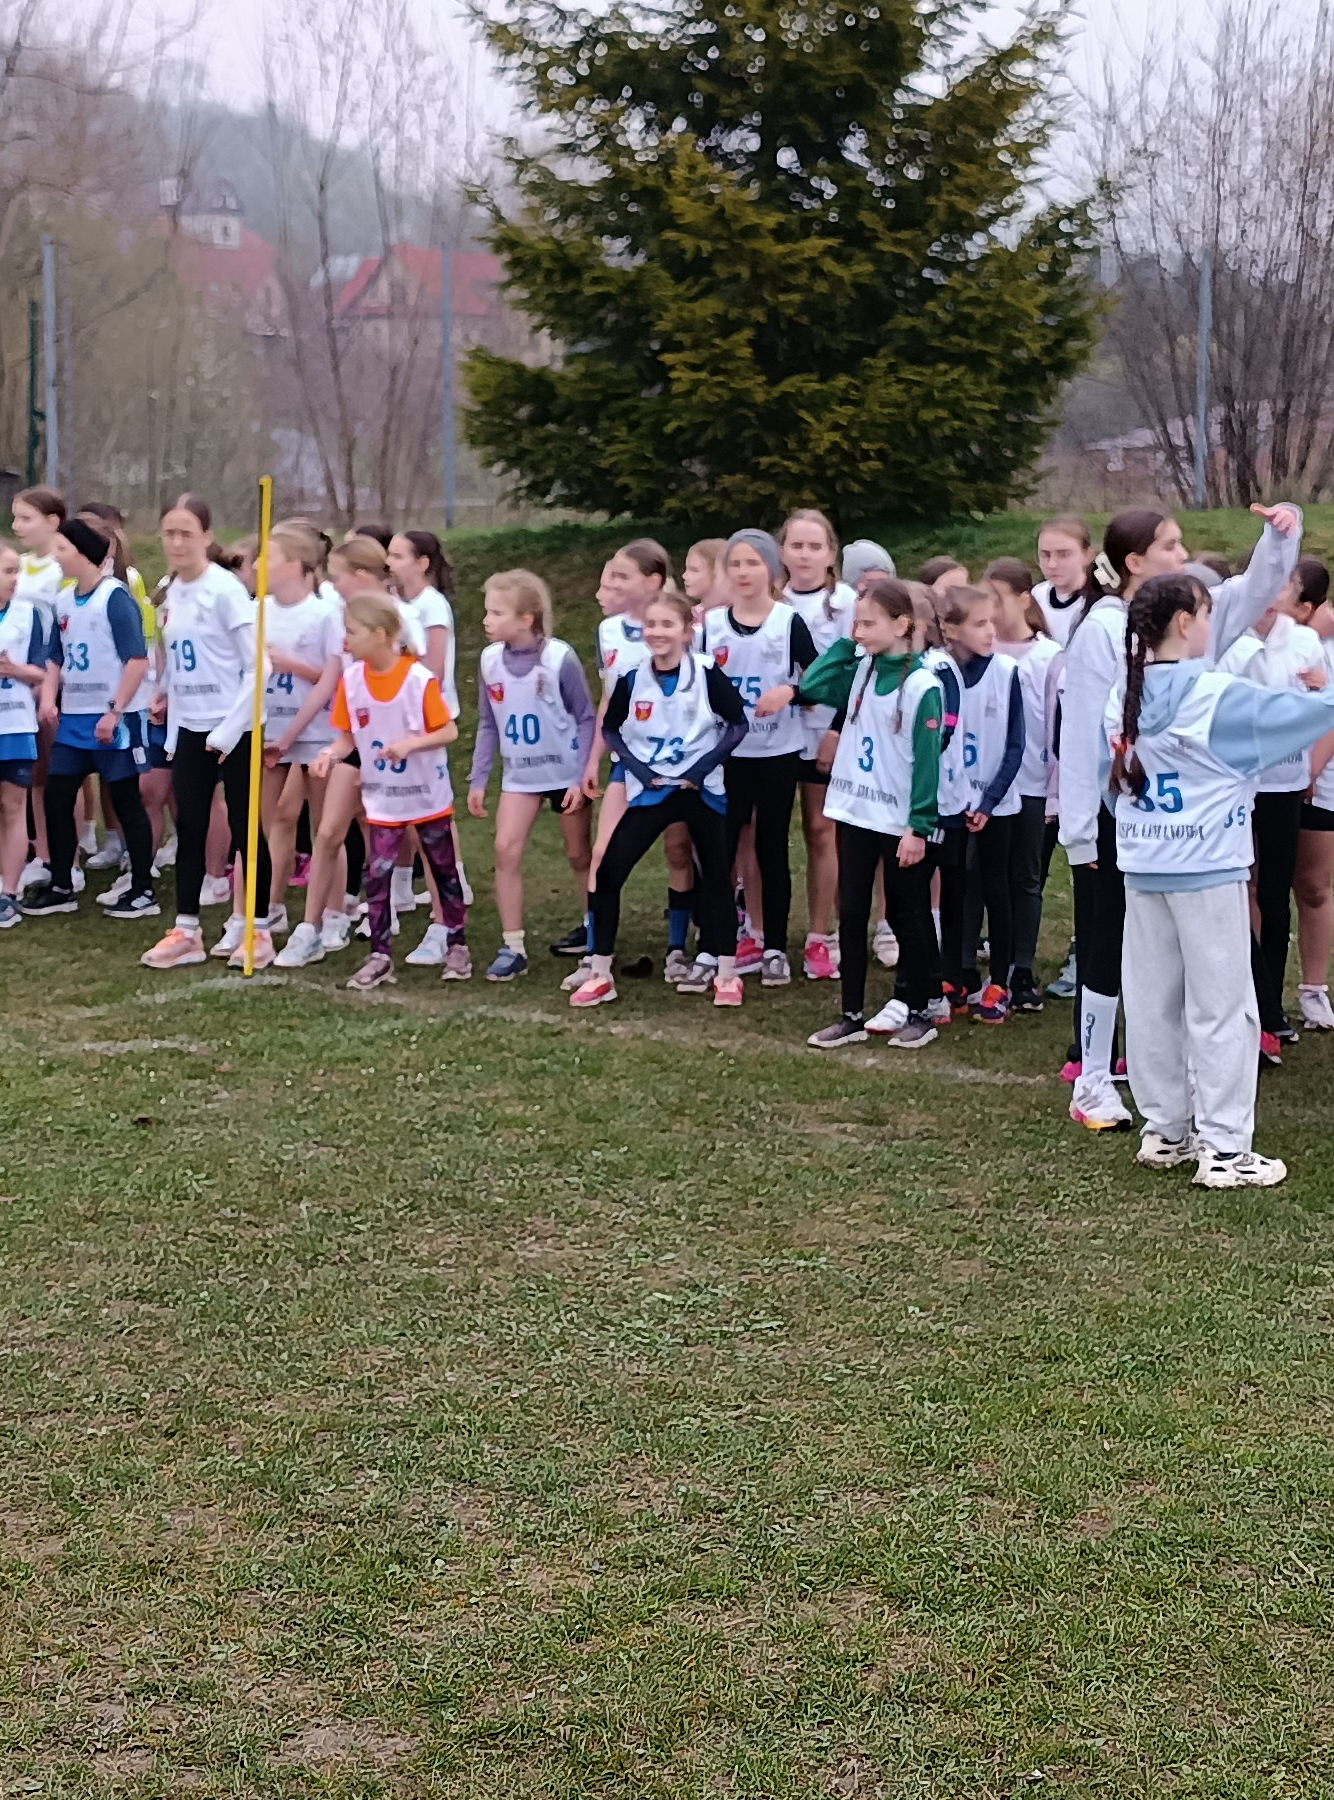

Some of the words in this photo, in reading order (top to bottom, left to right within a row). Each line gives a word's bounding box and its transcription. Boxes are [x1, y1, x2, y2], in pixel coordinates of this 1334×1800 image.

[170, 639, 196, 672] 19
[267, 671, 294, 695] 4
[505, 714, 541, 745] 40
[647, 735, 685, 766] 73
[857, 736, 874, 773] 3
